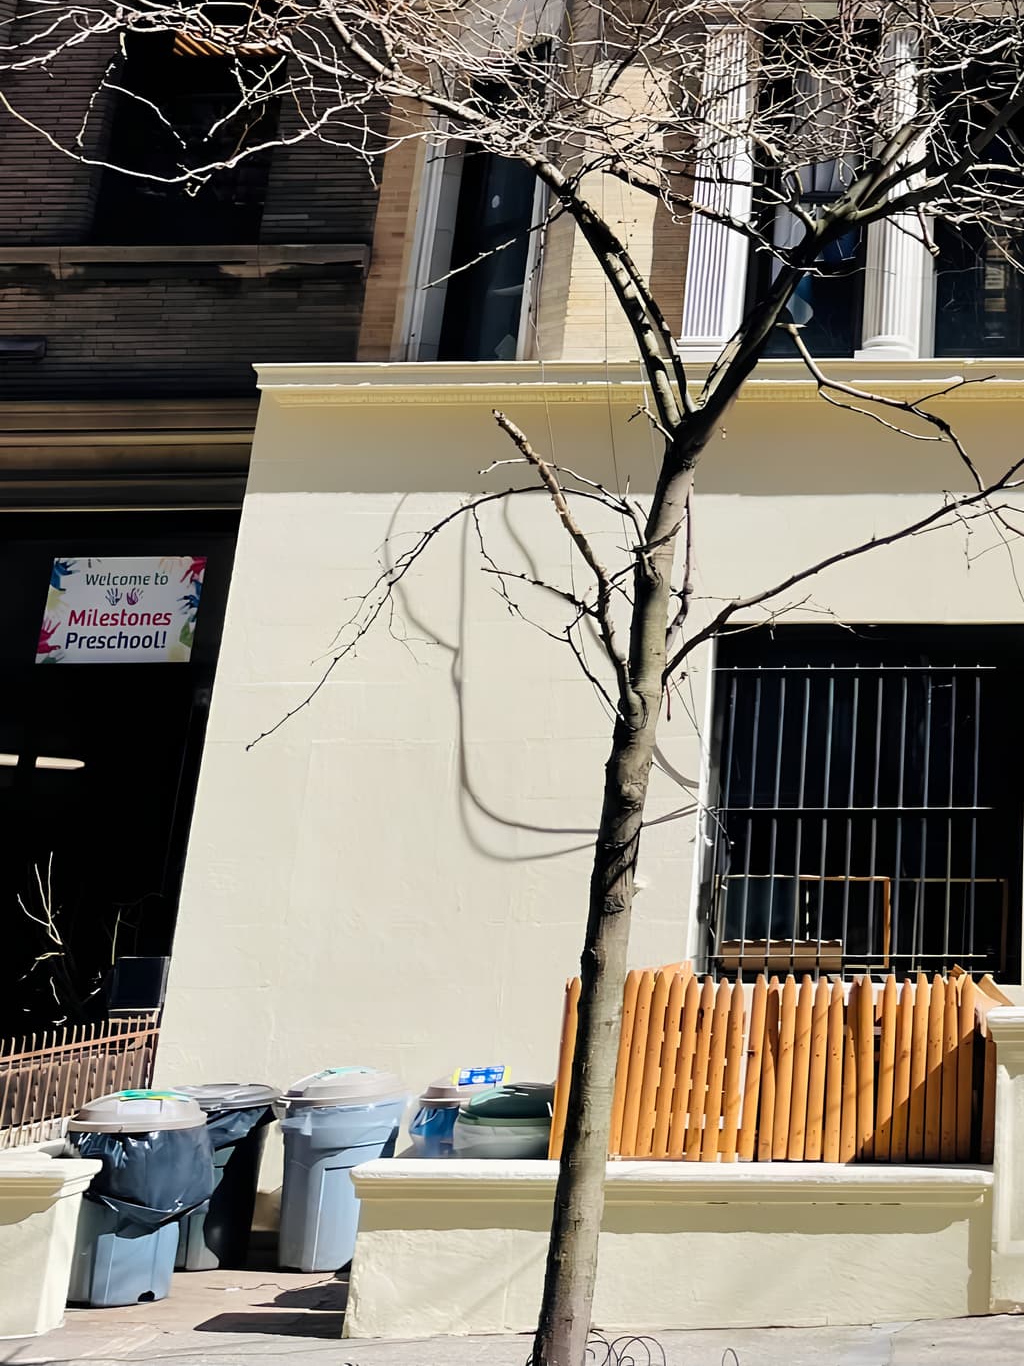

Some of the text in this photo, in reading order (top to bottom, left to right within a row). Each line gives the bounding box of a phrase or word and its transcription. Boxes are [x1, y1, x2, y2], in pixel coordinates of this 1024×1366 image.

[86, 572, 169, 586] Welcome to
[68, 609, 173, 627] Milestones
[65, 631, 167, 650] Preschool!
